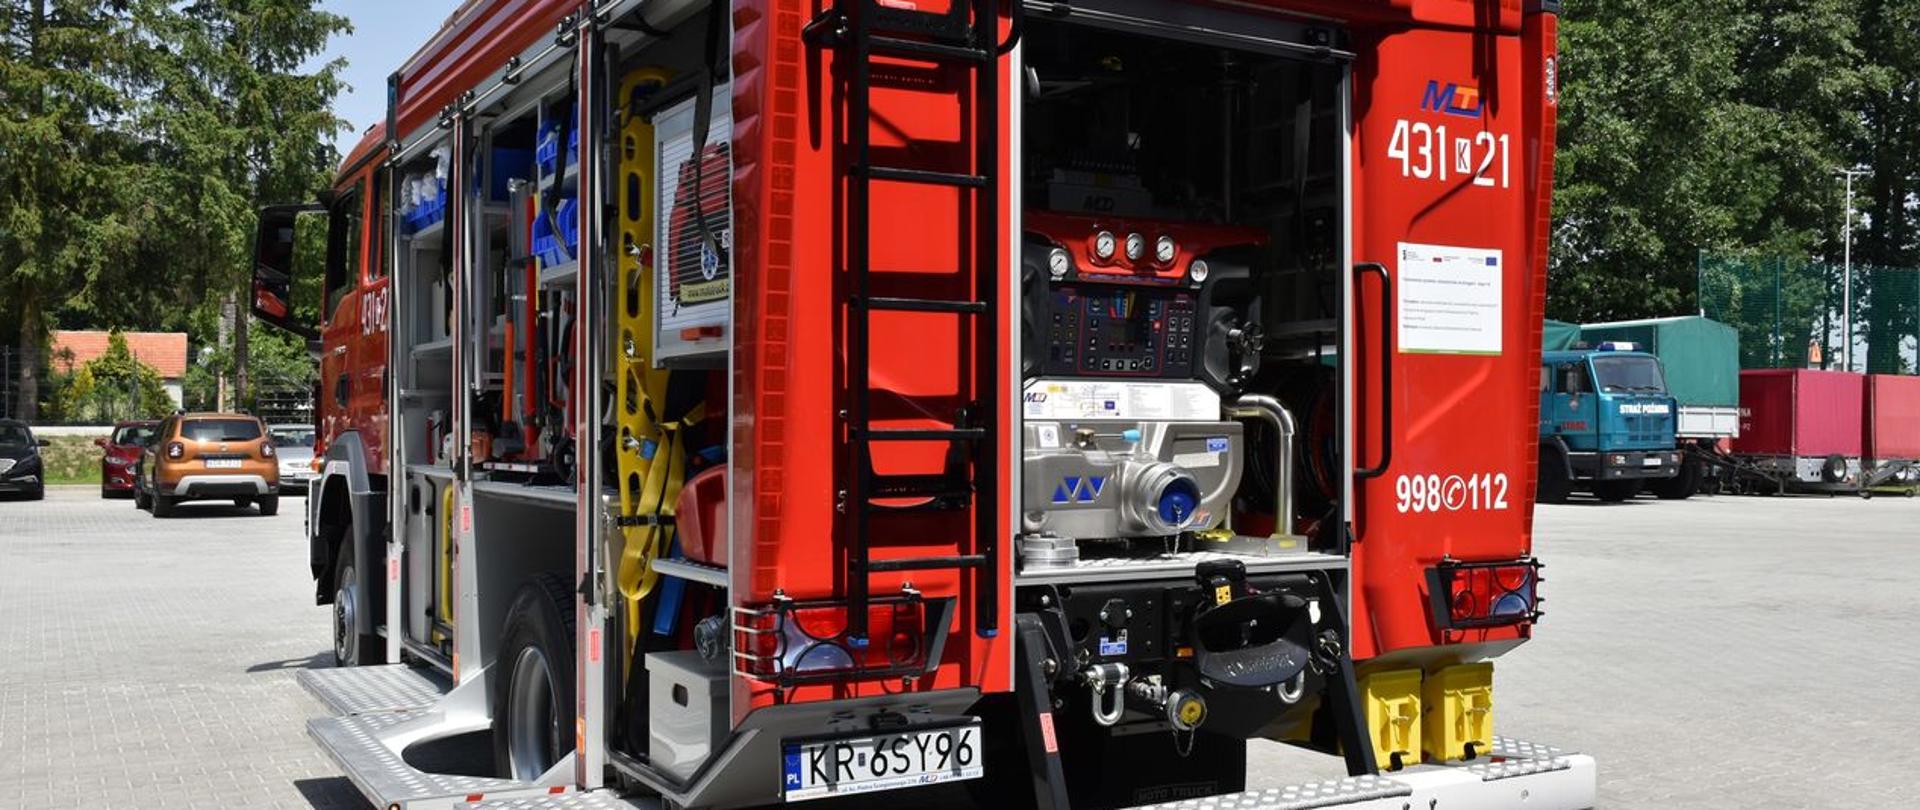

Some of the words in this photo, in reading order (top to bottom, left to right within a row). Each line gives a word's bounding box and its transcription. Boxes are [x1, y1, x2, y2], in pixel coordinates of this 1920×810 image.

[1388, 119, 1446, 181] 431
[1472, 131, 1509, 188] 21
[1396, 474, 1440, 513] 998
[1468, 473, 1508, 511] 112
[786, 773, 801, 785] PL
[809, 743, 855, 786] KR
[870, 729, 973, 778] 6SY96
